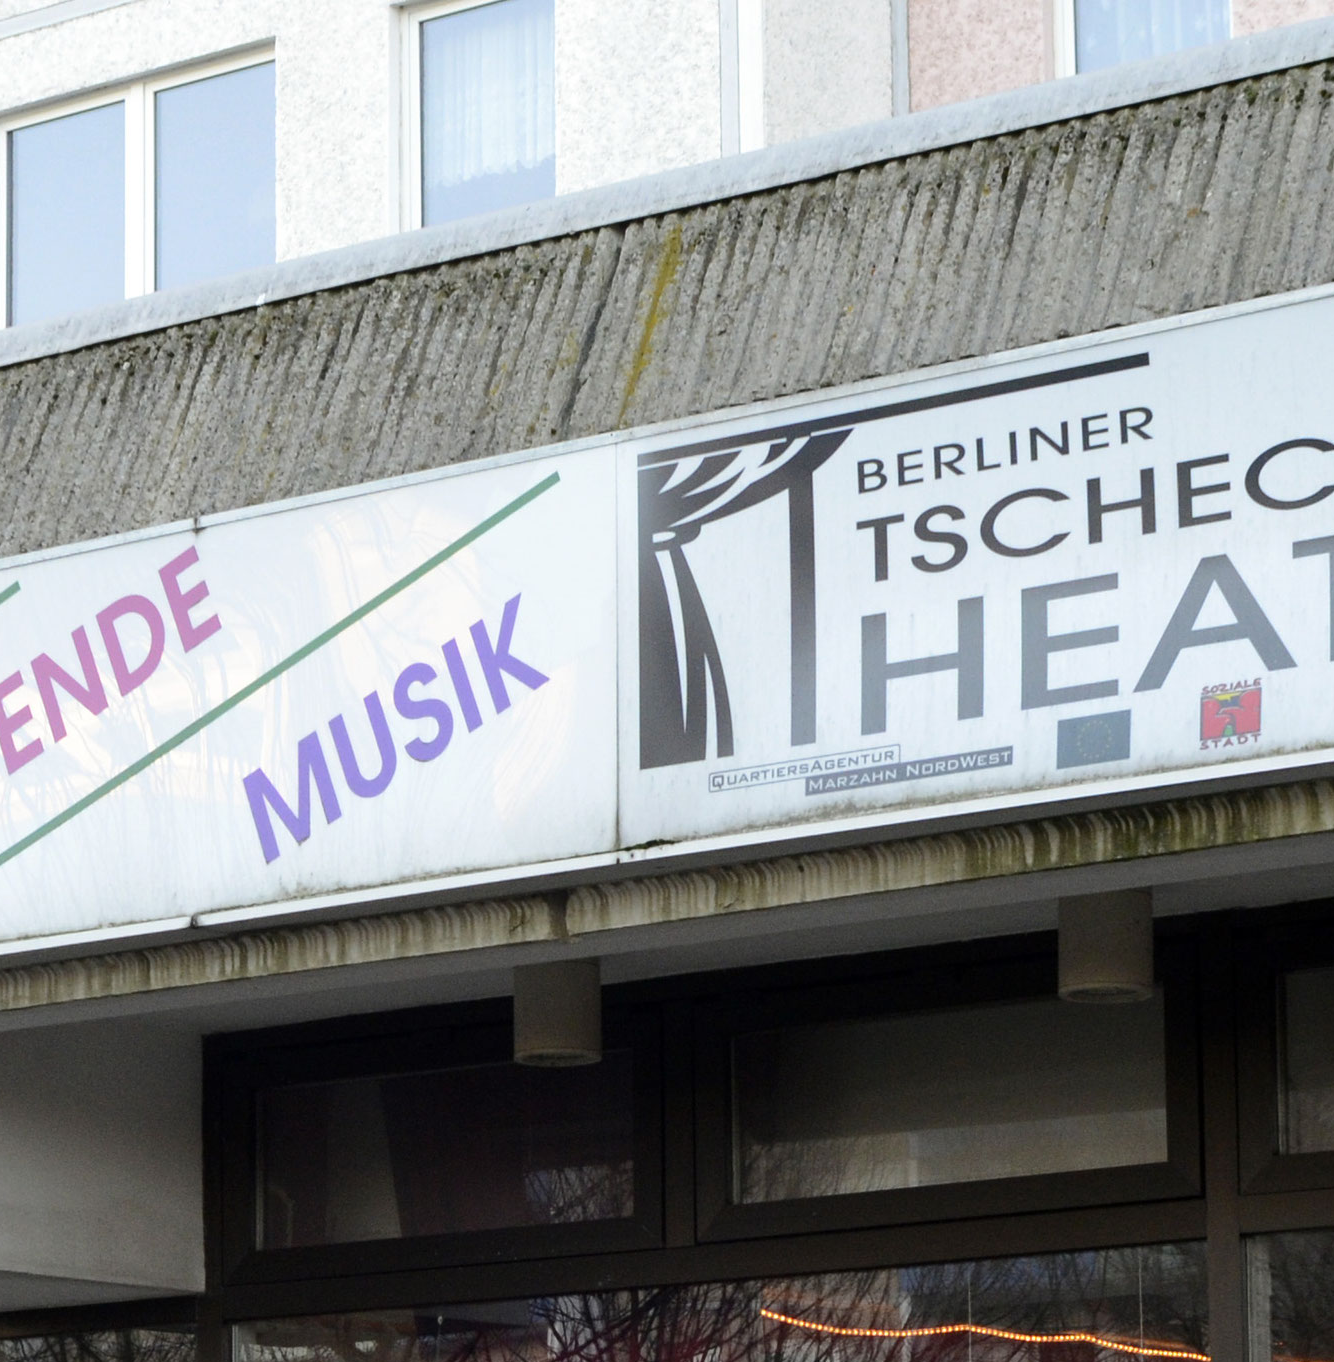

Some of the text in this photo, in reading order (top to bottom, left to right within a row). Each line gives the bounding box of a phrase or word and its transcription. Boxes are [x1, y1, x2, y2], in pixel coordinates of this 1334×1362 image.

[857, 407, 1155, 493] BERLINER
[1202, 678, 1262, 694] SOZIALE
[242, 592, 550, 864] MUSIK
[1199, 733, 1262, 750] STADT
[808, 769, 897, 792] MARZAHN
